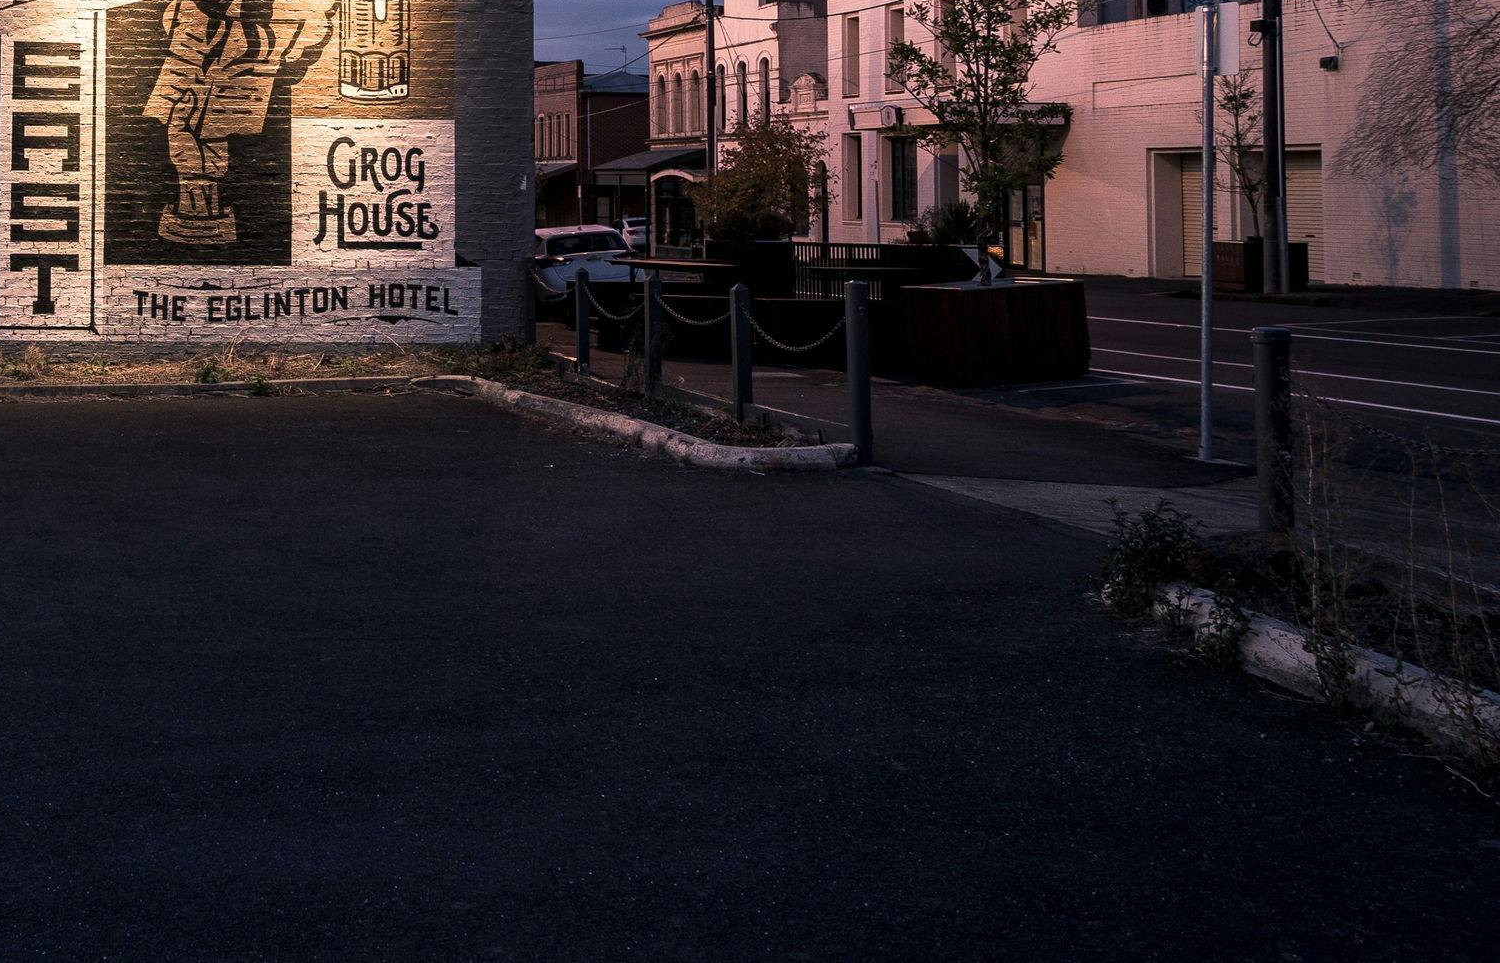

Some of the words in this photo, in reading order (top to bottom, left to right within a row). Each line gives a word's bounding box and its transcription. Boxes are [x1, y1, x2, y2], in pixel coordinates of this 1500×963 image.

[10, 40, 81, 316] EAST
[132, 290, 185, 322] THE
[208, 285, 349, 322] EGLINTON
[368, 283, 459, 316] HOTEL
